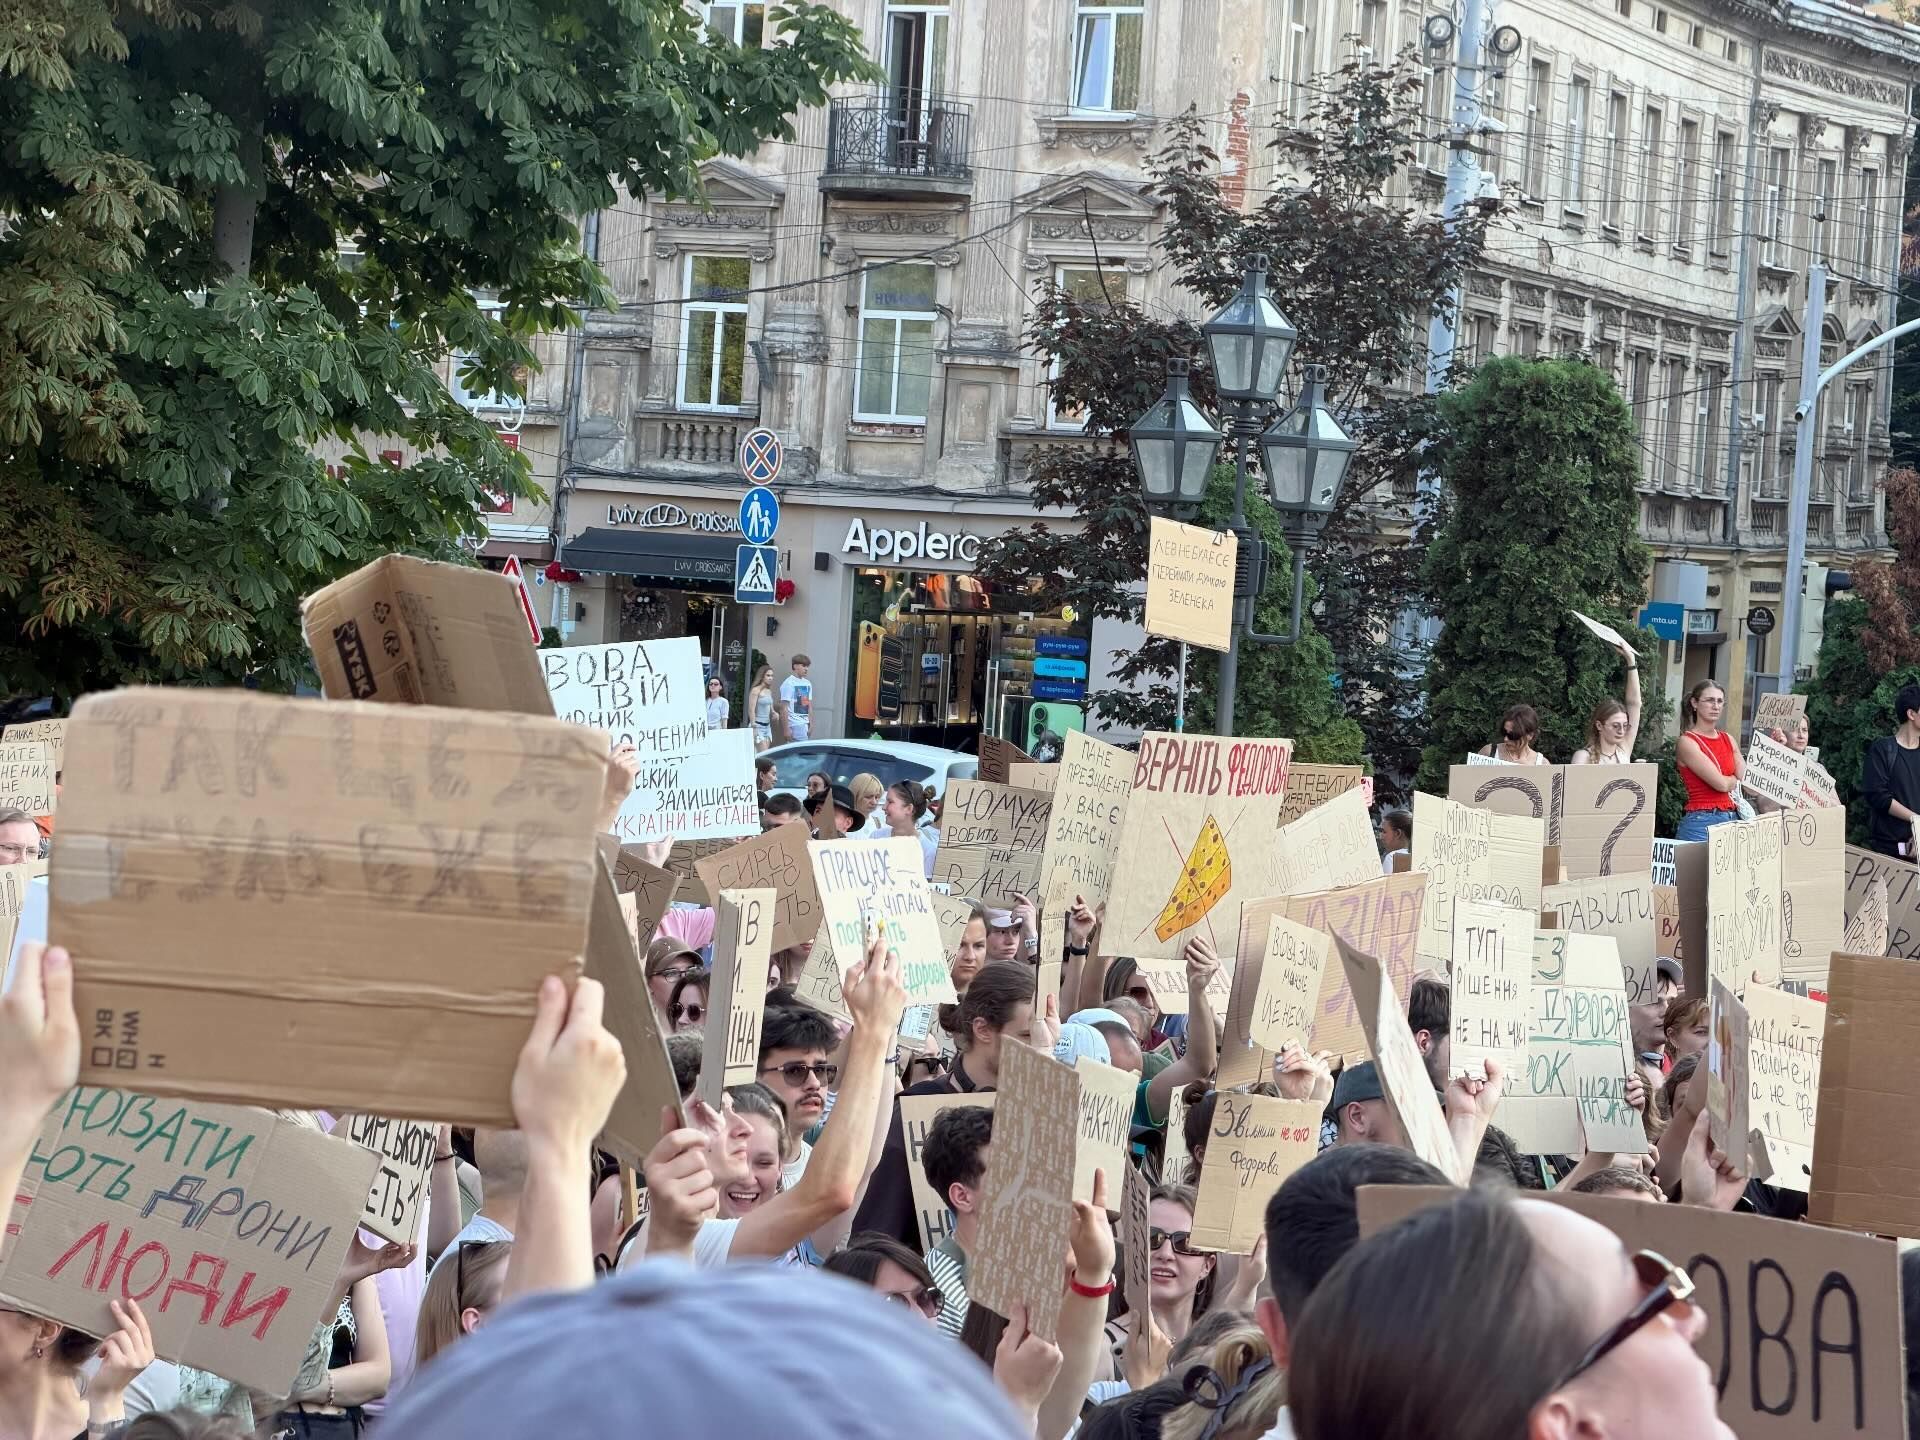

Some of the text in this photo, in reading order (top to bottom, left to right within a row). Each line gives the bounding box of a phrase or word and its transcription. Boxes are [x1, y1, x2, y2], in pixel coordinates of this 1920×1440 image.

[842, 518, 1004, 563] Applero
[1651, 616, 1678, 626] mta.ua
[343, 642, 371, 698] JYSK
[545, 645, 654, 691] ВОВА
[558, 709, 636, 729] ИРНИК
[89, 702, 294, 796] ТАК
[332, 711, 472, 813] ЦЕ
[1133, 738, 1291, 798] ВЕРНІТЬ ФЕДОРОВА
[656, 784, 754, 812] ЗАЛИШИТЬСЯ
[693, 809, 713, 829] НЕ
[715, 804, 760, 826] СТАНЕ
[947, 825, 999, 848] РОБИТЬ
[1465, 923, 1506, 973] ТУПІ
[94, 1009, 113, 1039] BK
[121, 1010, 140, 1045] WH
[1230, 1150, 1279, 1189] Федорова
[140, 1174, 333, 1273] ДРОНИ
[46, 1221, 293, 1342] ЛЮДИ
